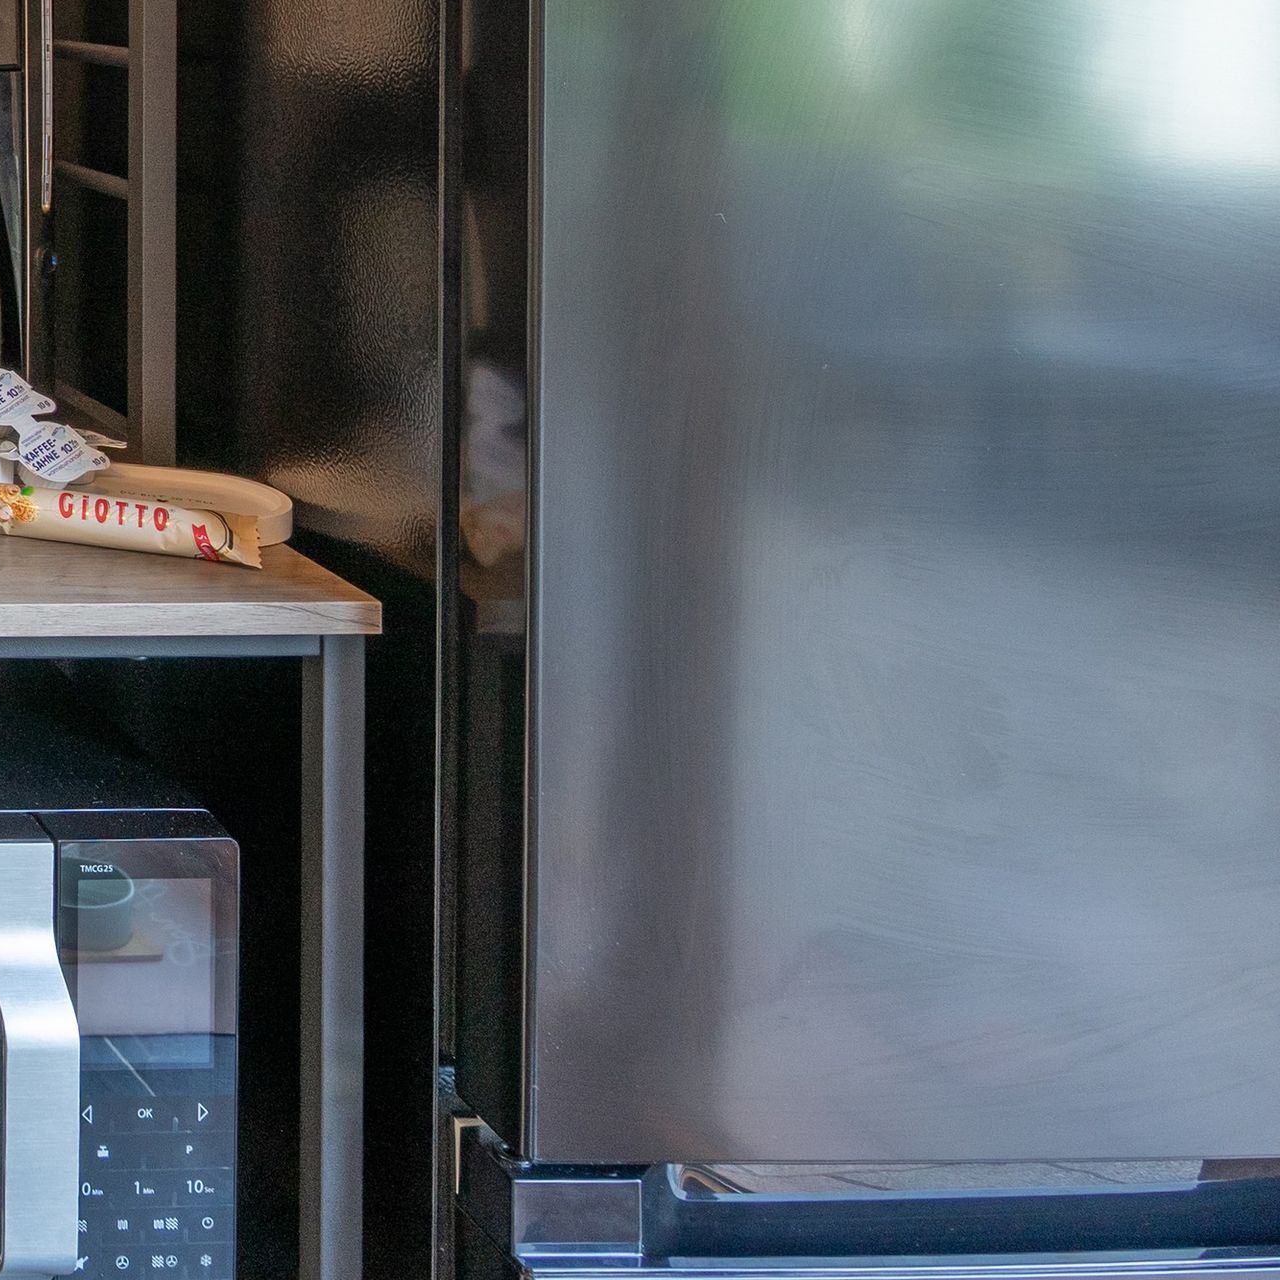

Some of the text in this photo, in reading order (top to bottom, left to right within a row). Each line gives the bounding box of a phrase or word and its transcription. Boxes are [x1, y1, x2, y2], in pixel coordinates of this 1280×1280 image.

[23, 439, 57, 463] KAFFEE-
[32, 450, 60, 472] SAHNE
[80, 864, 114, 873] TMCG25
[137, 1108, 154, 1119] OK
[185, 1144, 193, 1155] P
[92, 1188, 104, 1196] Min
[134, 1181, 155, 1195] 1 Min
[186, 1180, 215, 1194] 10 Sec
